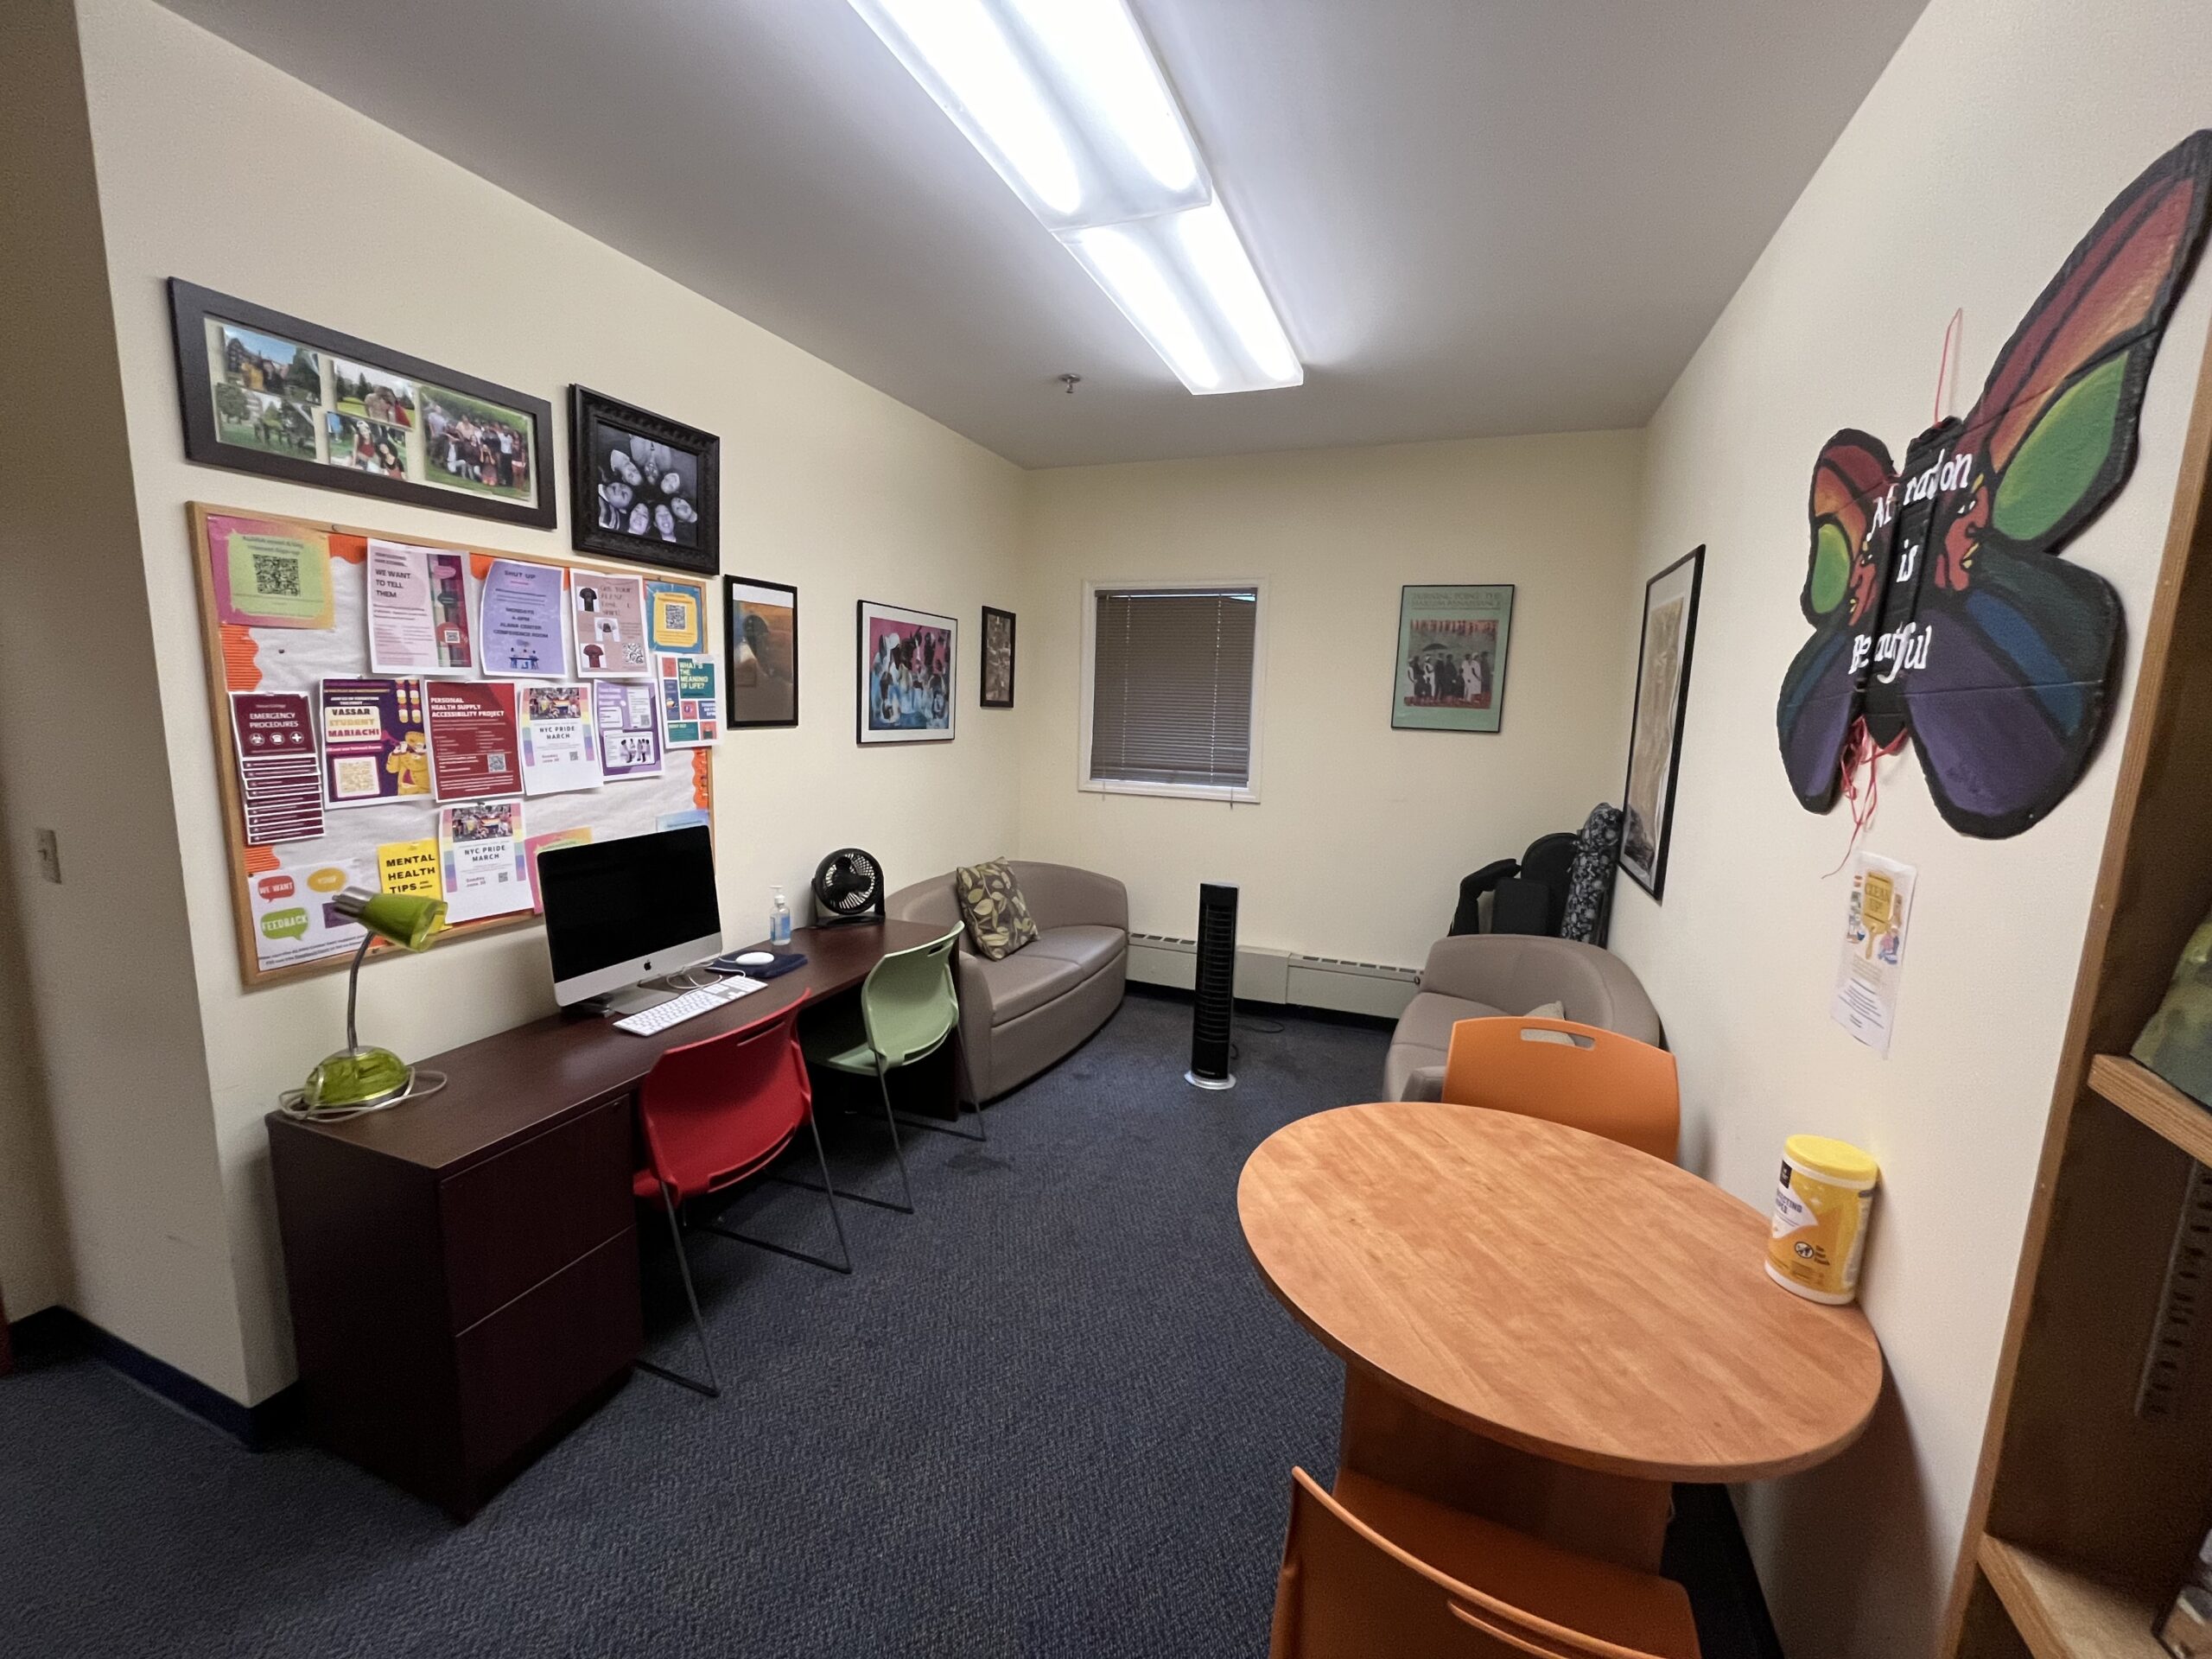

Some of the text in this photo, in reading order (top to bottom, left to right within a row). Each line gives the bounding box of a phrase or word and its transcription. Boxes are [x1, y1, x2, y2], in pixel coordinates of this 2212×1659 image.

[1896, 538, 1920, 582] is
[388, 570, 411, 579] WANT
[376, 589, 397, 598] THEM
[328, 728, 379, 737] MARIACHI
[386, 854, 435, 867] MENTAL
[388, 867, 435, 881] HEALTH
[273, 882, 294, 893] WANT
[390, 883, 417, 894] TIPS
[261, 914, 308, 931] FEEDBACK
